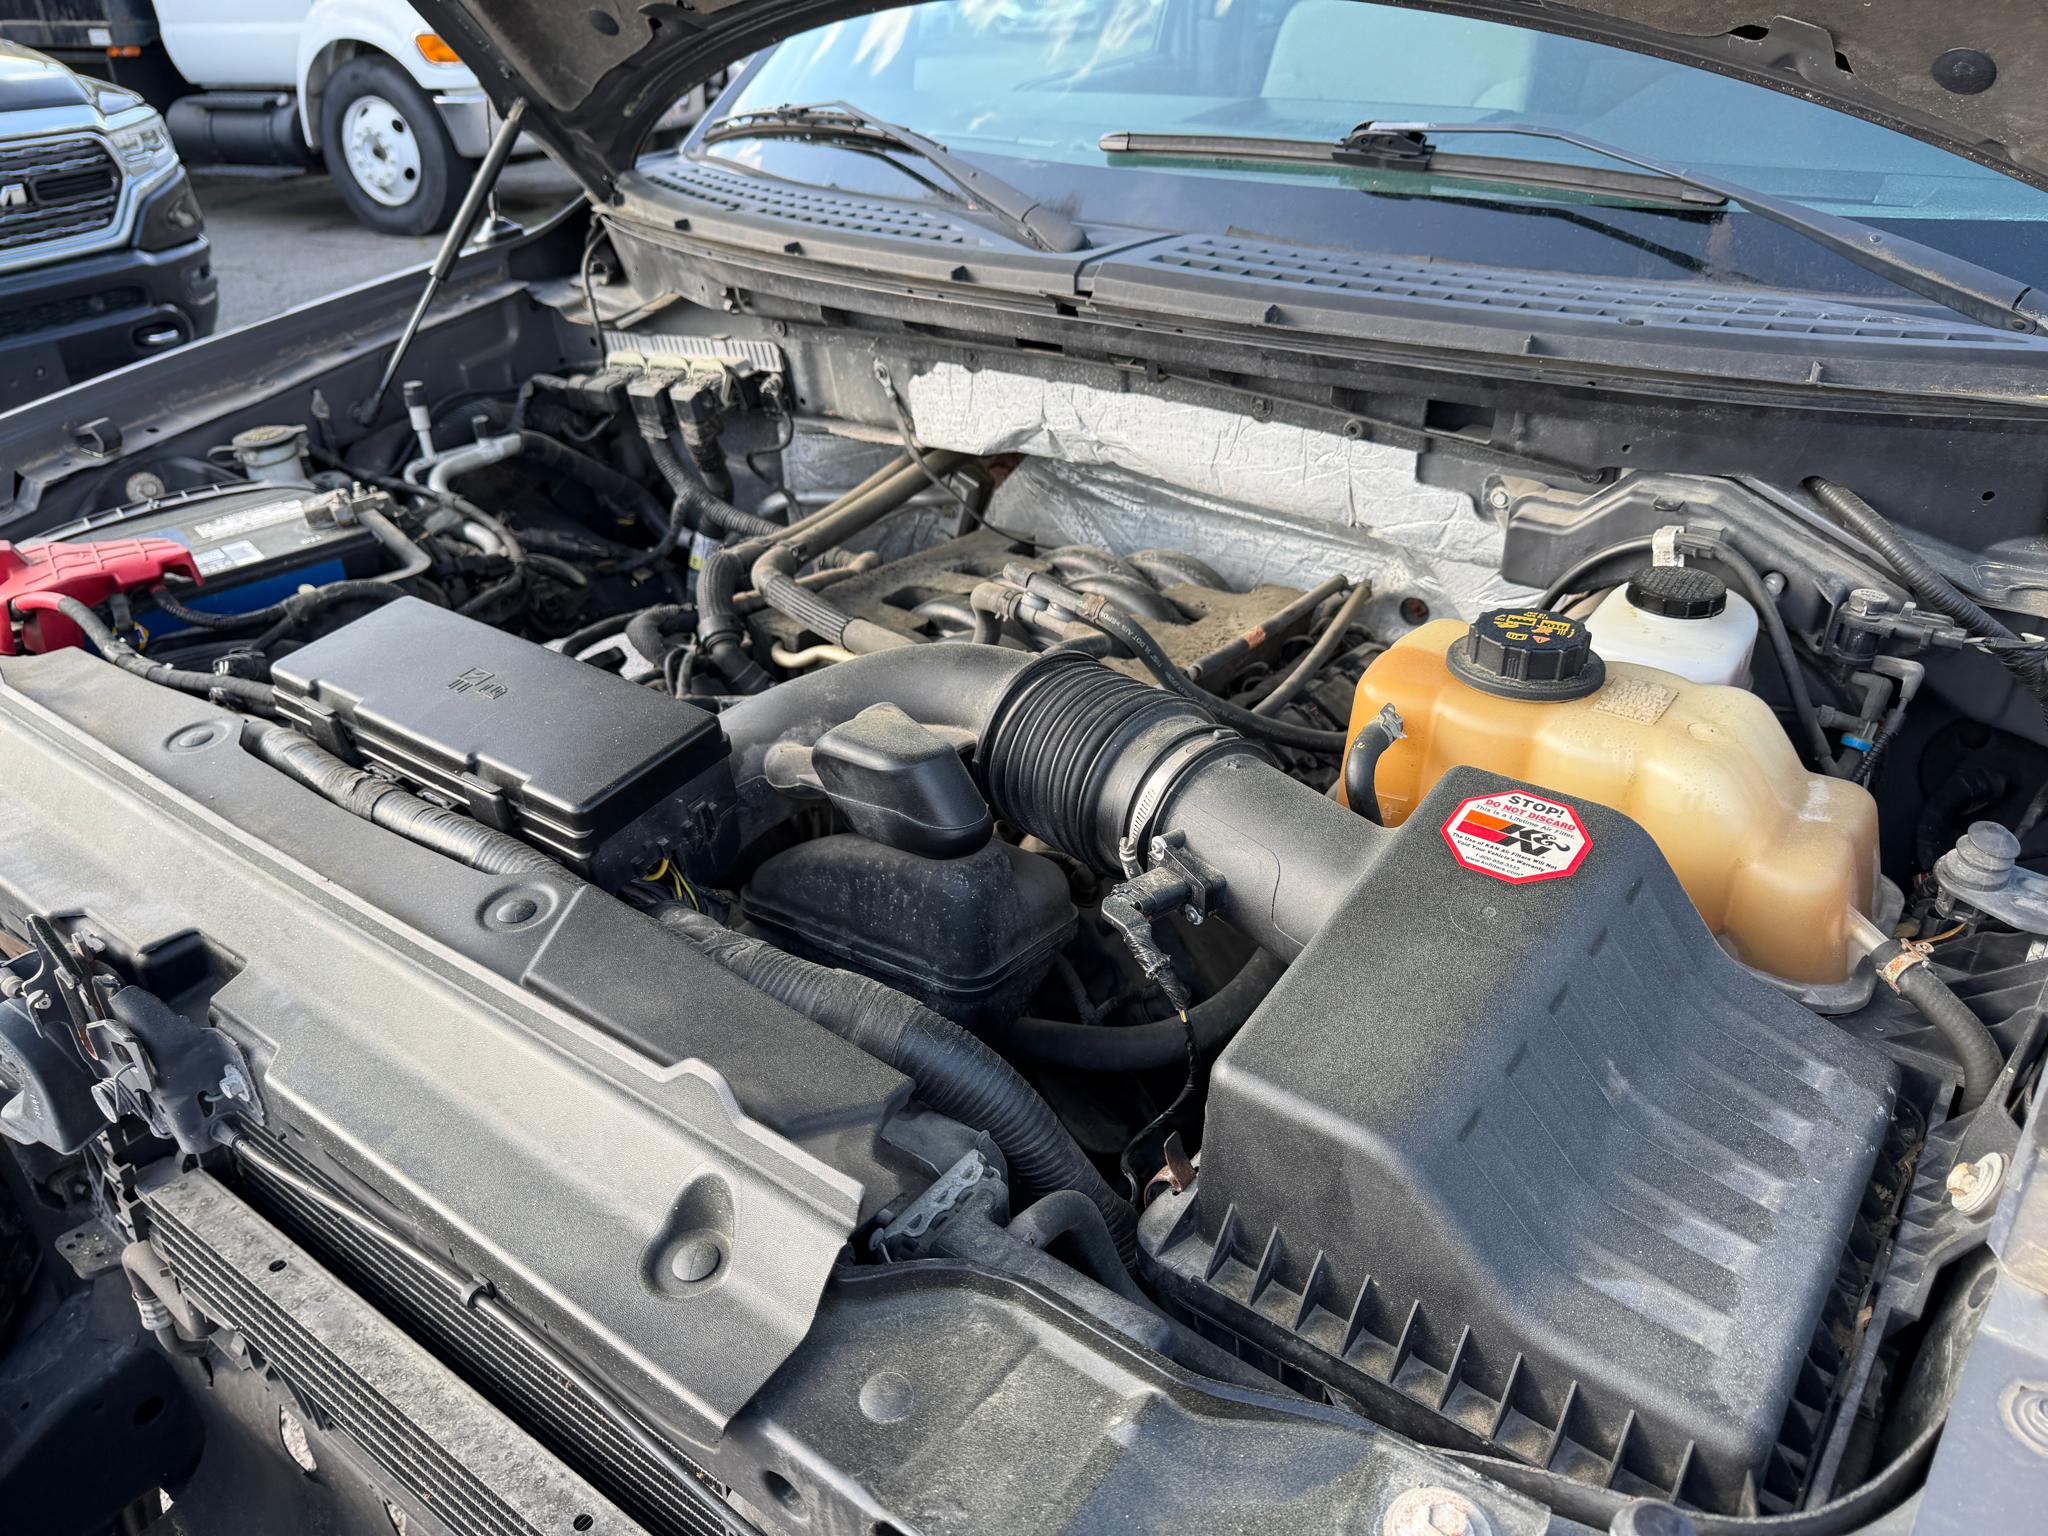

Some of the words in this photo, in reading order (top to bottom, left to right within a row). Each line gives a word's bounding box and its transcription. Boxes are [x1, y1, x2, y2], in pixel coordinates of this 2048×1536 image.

[1476, 804, 1491, 812] This
[1509, 815, 1539, 828] Lifetime
[1540, 824, 1552, 832] Air
[1554, 828, 1575, 840] Filter.
[1486, 799, 1500, 808] DO
[1503, 804, 1528, 815] NOT
[1528, 812, 1576, 831] DISCARD
[1509, 796, 1565, 818] STOP!
[1457, 840, 1471, 848] Void
[1472, 844, 1487, 854] Your
[1516, 858, 1545, 872] Warranty
[1496, 824, 1570, 856] K&N
[1500, 847, 1510, 855] Air
[1511, 850, 1532, 860] Filters
[1533, 857, 1544, 865] Will
[1546, 862, 1558, 870] Not
